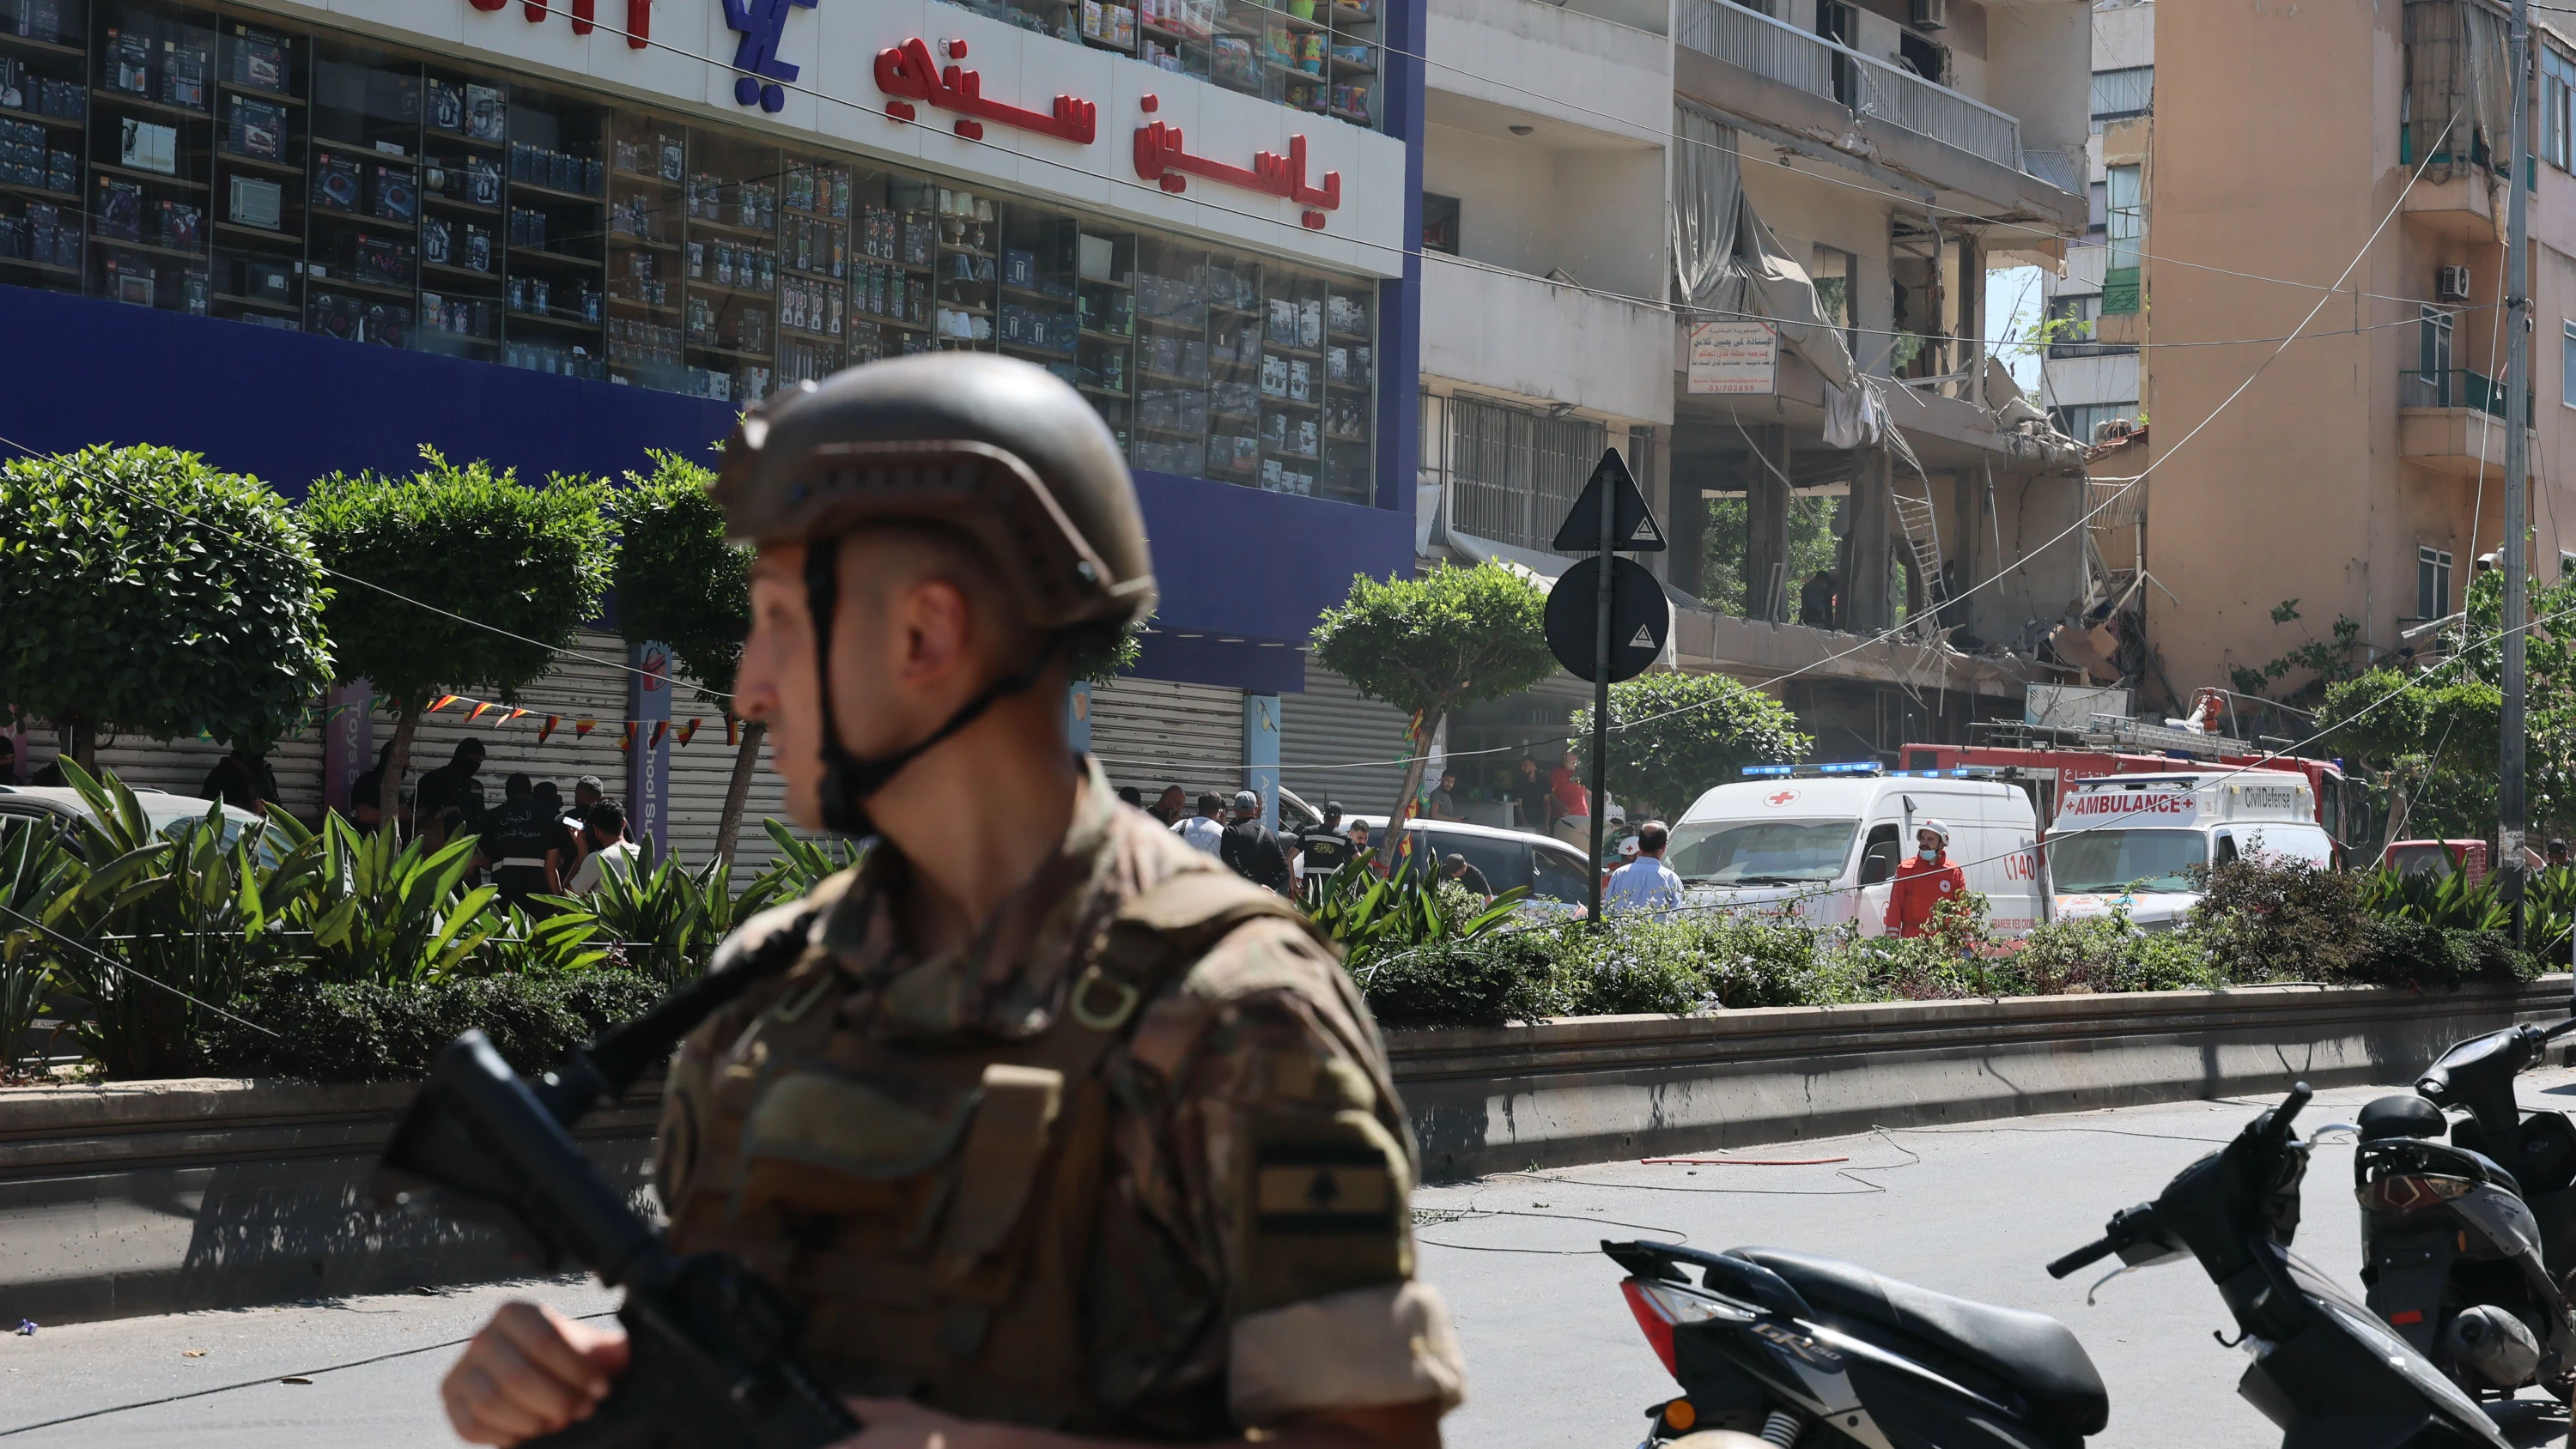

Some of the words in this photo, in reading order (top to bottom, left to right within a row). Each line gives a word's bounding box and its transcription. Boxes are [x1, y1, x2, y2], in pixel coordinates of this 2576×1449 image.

[1133, 94, 1340, 230] ياسين
[347, 700, 361, 764] Toys
[2075, 794, 2181, 815] AMBULANCE
[2245, 787, 2262, 808] Civil
[2263, 787, 2291, 808] Defense
[500, 810, 532, 825] الجيش
[2010, 854, 2035, 881] 140
